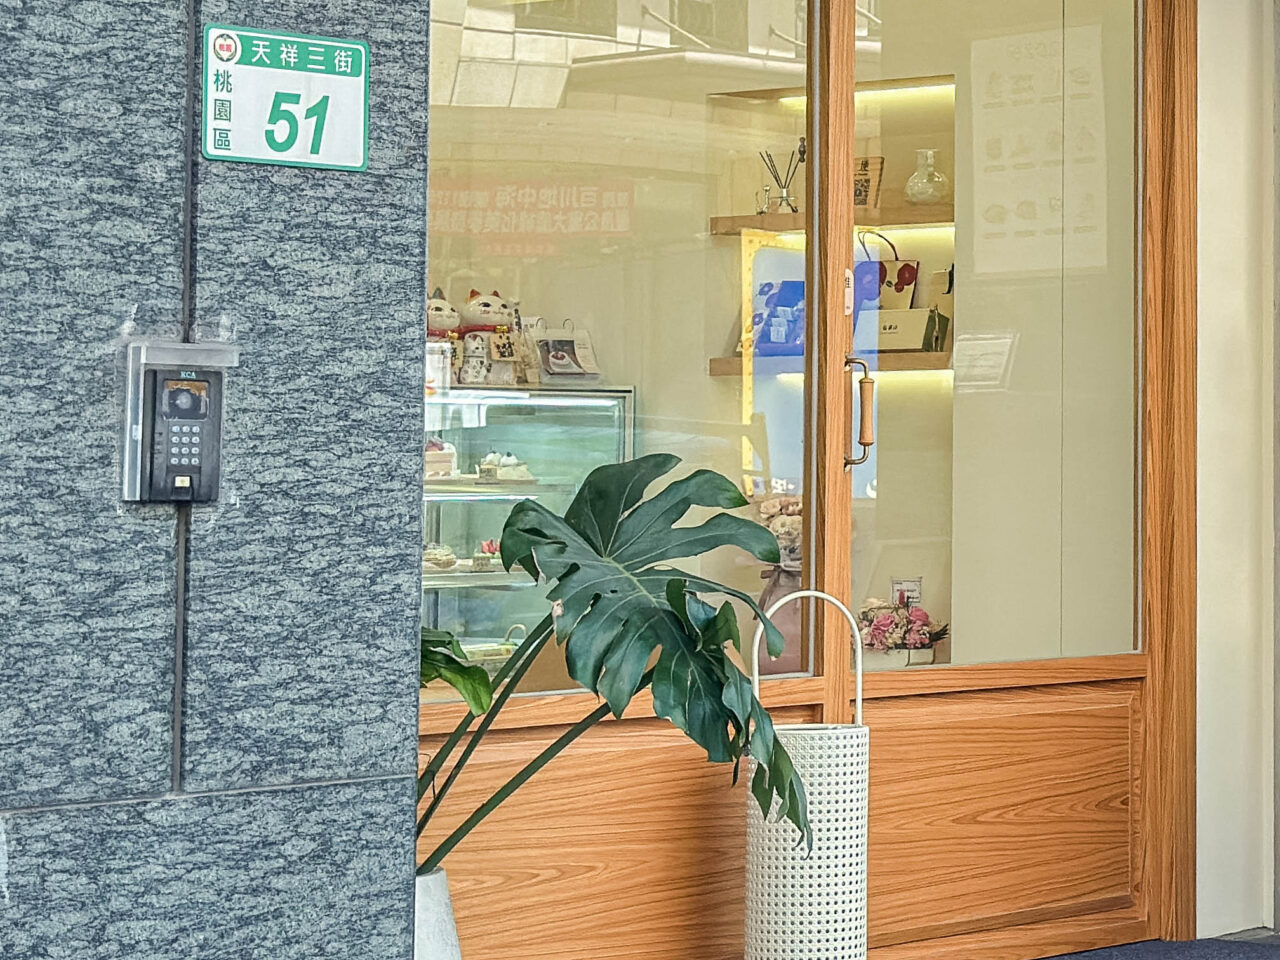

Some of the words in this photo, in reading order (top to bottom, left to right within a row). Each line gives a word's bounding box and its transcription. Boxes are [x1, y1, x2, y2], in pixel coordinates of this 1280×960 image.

[251, 40, 353, 74] 天祥三街
[213, 69, 233, 151] 桃園區
[264, 91, 330, 156] 51
